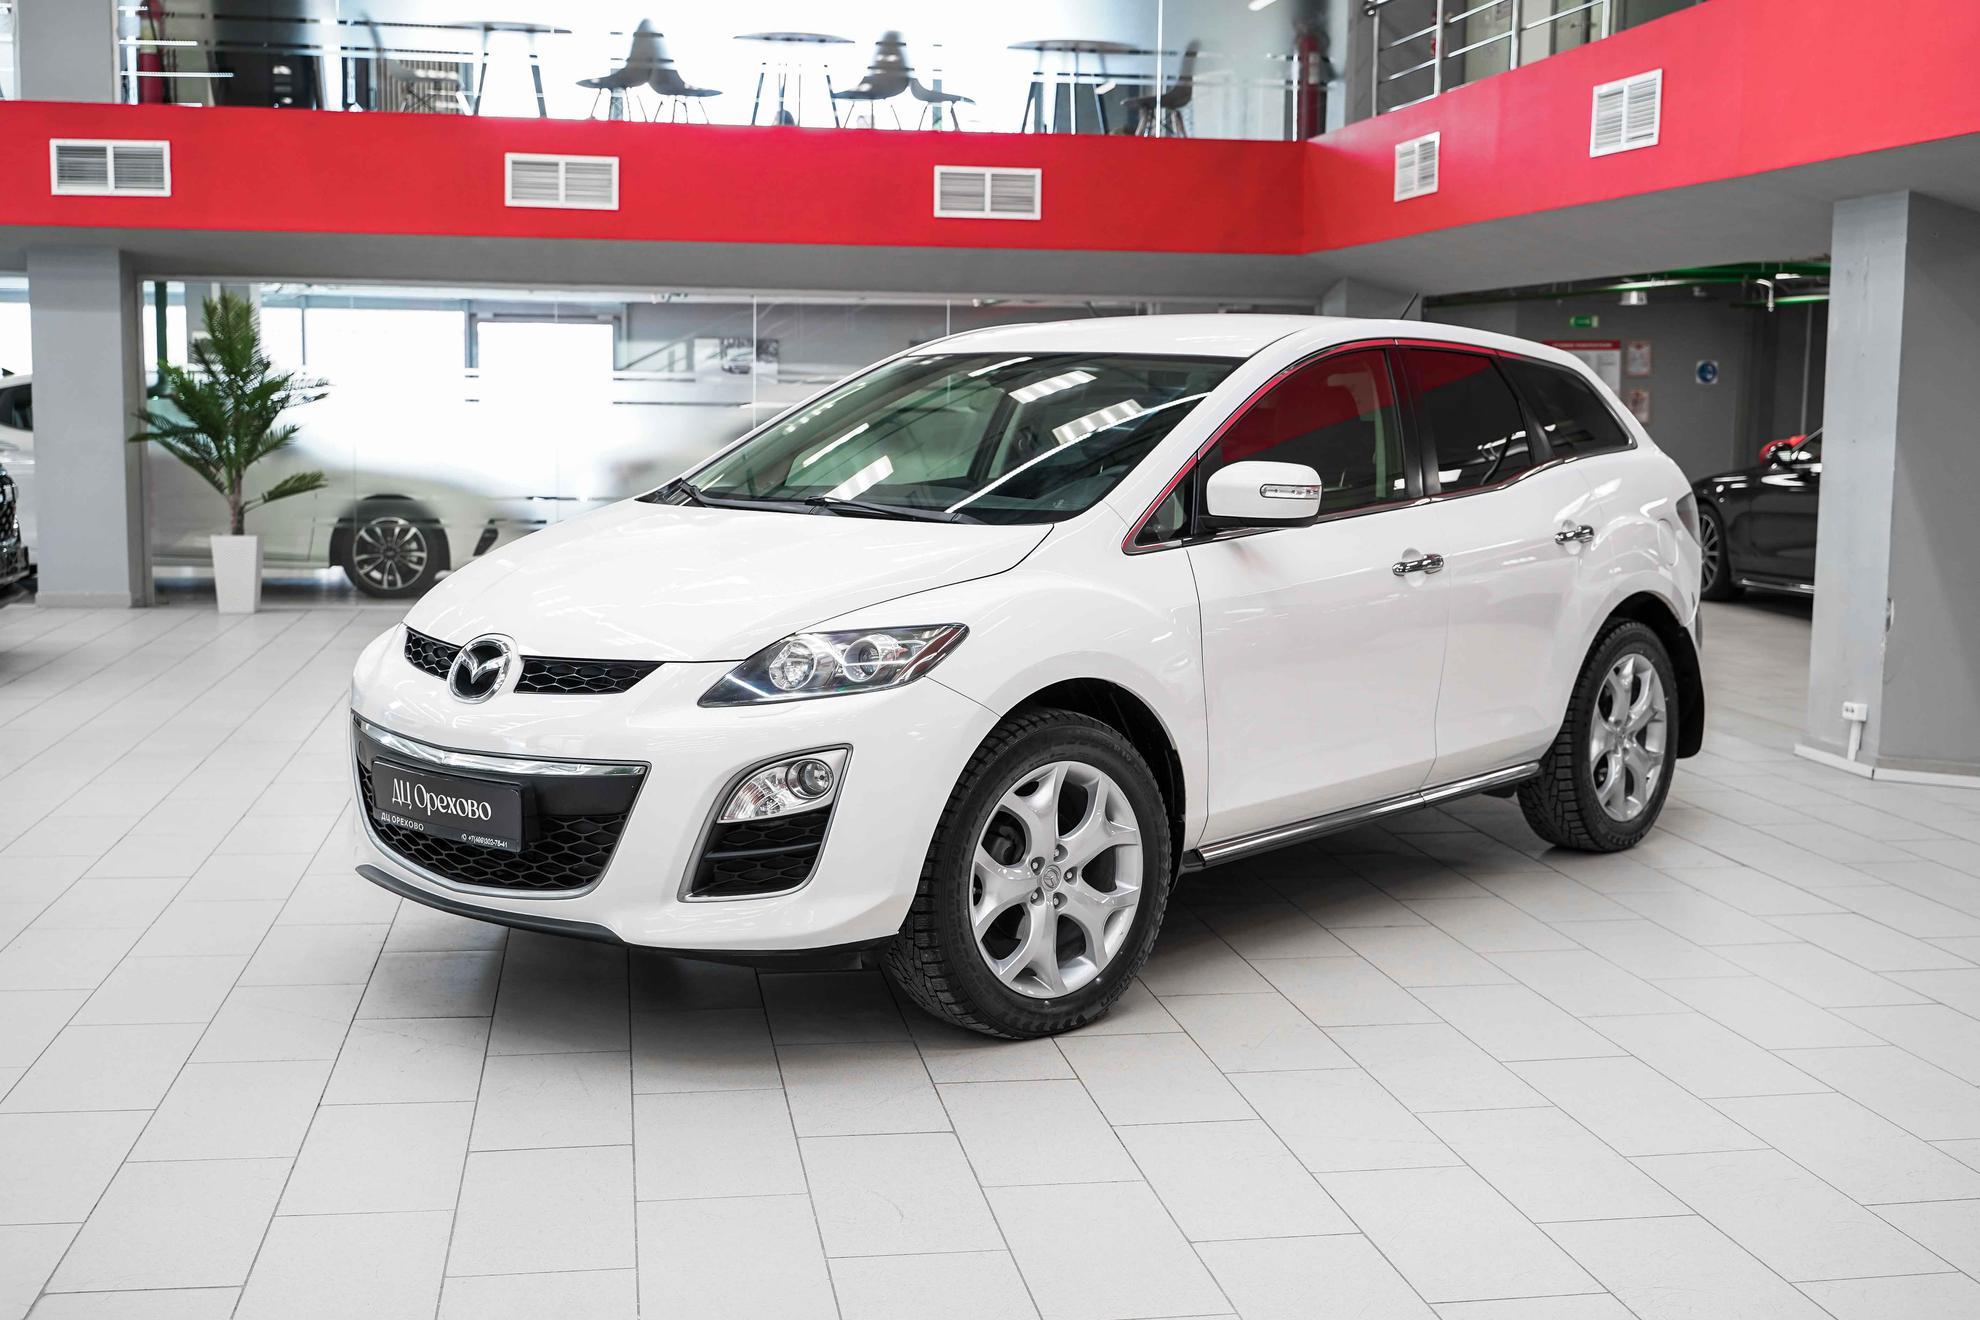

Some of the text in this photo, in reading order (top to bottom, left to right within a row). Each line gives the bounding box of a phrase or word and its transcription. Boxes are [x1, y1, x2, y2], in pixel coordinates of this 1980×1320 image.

[392, 778, 491, 820] ДЦ Орехово
[381, 812, 424, 831] ДЦ ОРЕХОВО
